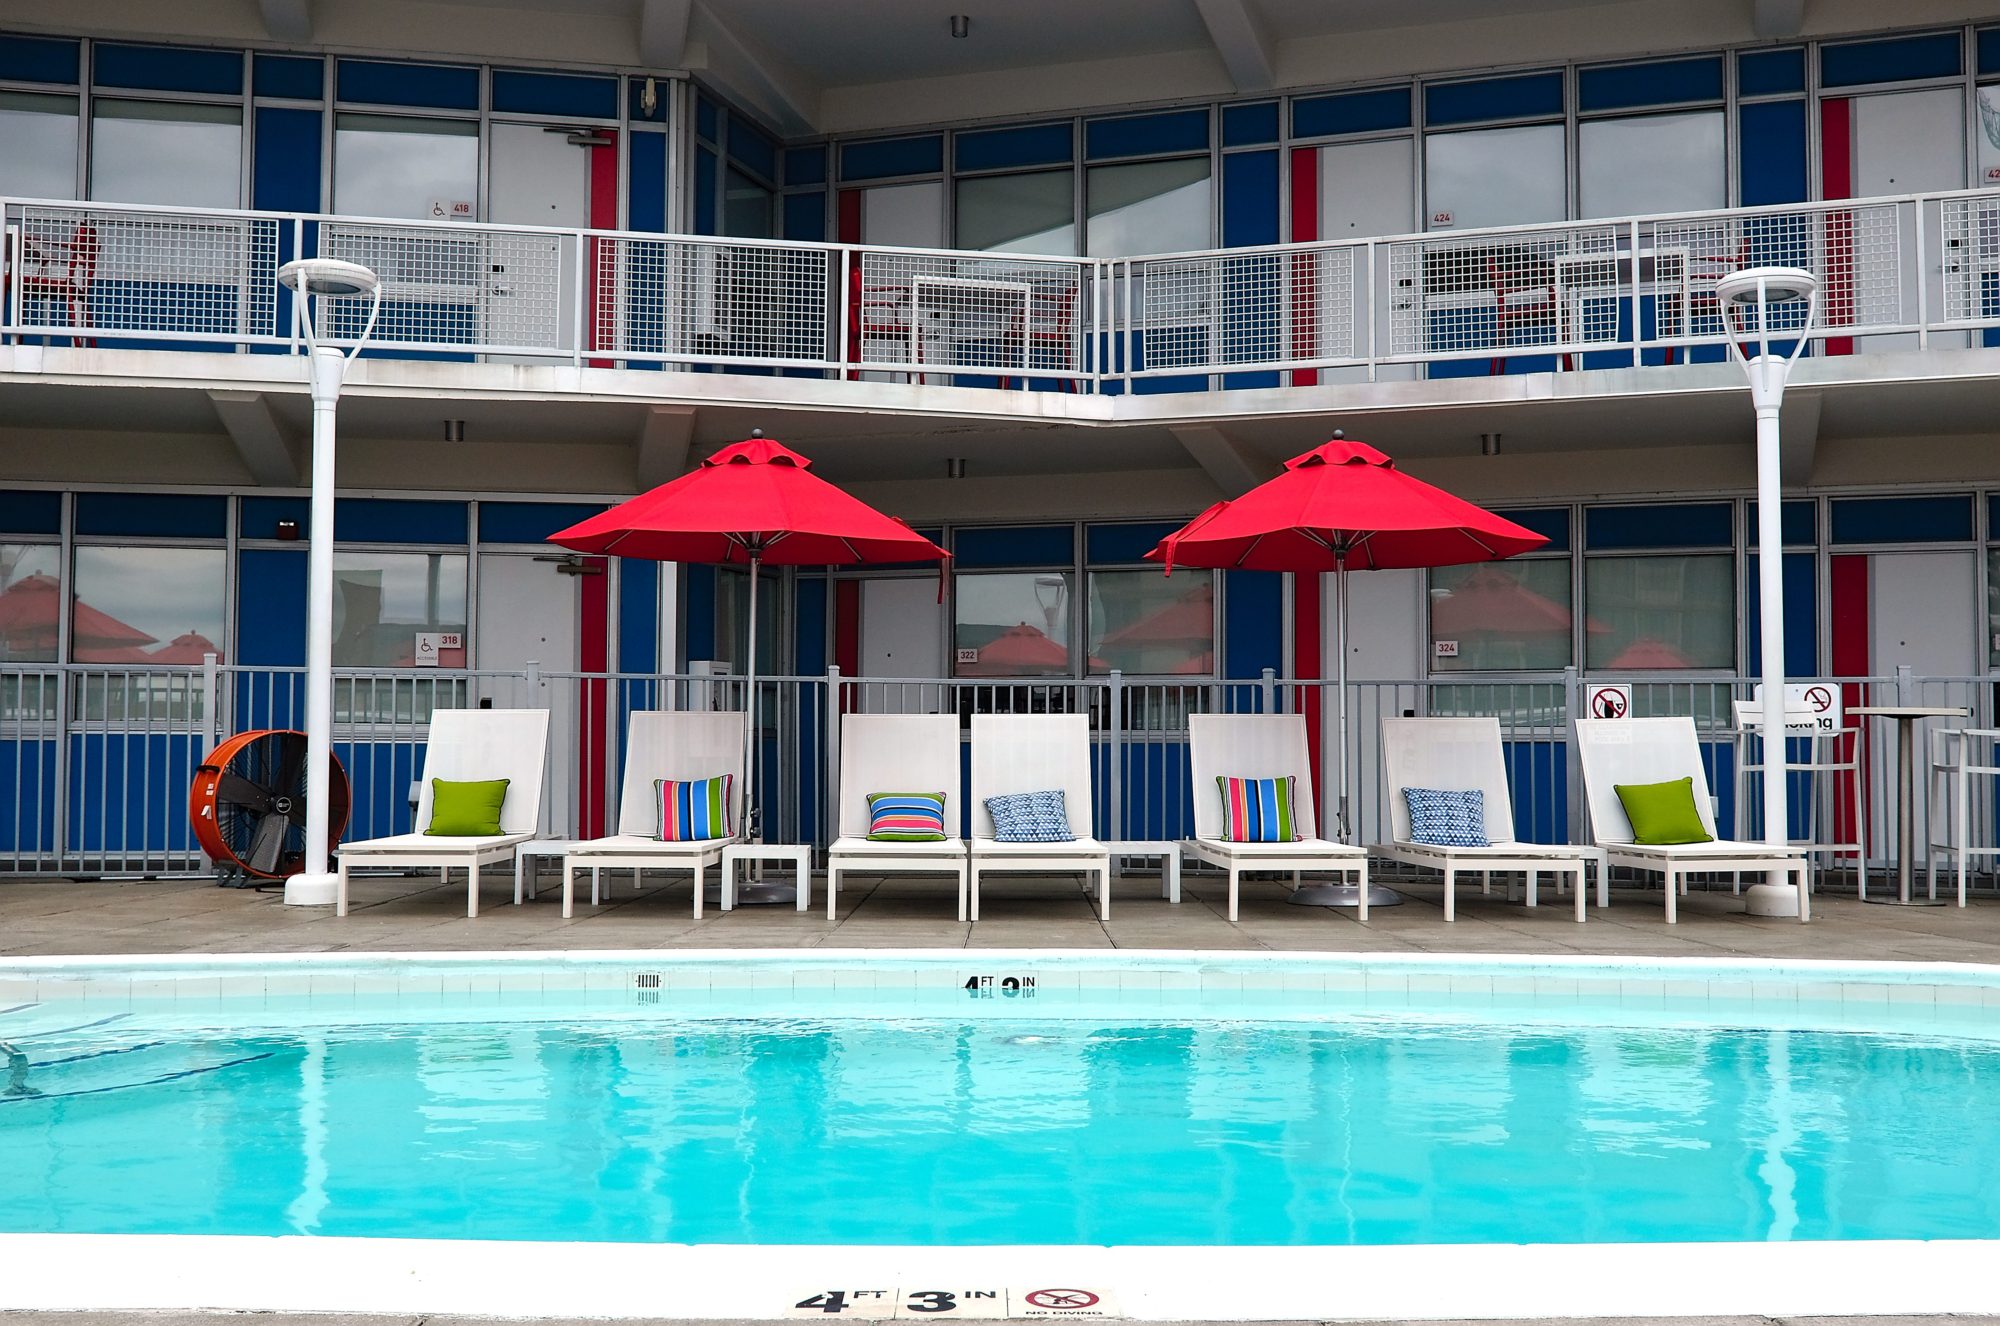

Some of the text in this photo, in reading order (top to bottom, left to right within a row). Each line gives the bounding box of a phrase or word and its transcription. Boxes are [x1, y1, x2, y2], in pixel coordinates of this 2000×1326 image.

[454, 203, 469, 212] 418
[1434, 213, 1450, 222] 424
[442, 635, 458, 644] 318
[1438, 643, 1455, 652] 324
[960, 651, 975, 660] 322
[981, 976, 994, 987] FT
[1022, 976, 1035, 987] IN
[795, 1290, 996, 1313] 4 FT 3 IN
